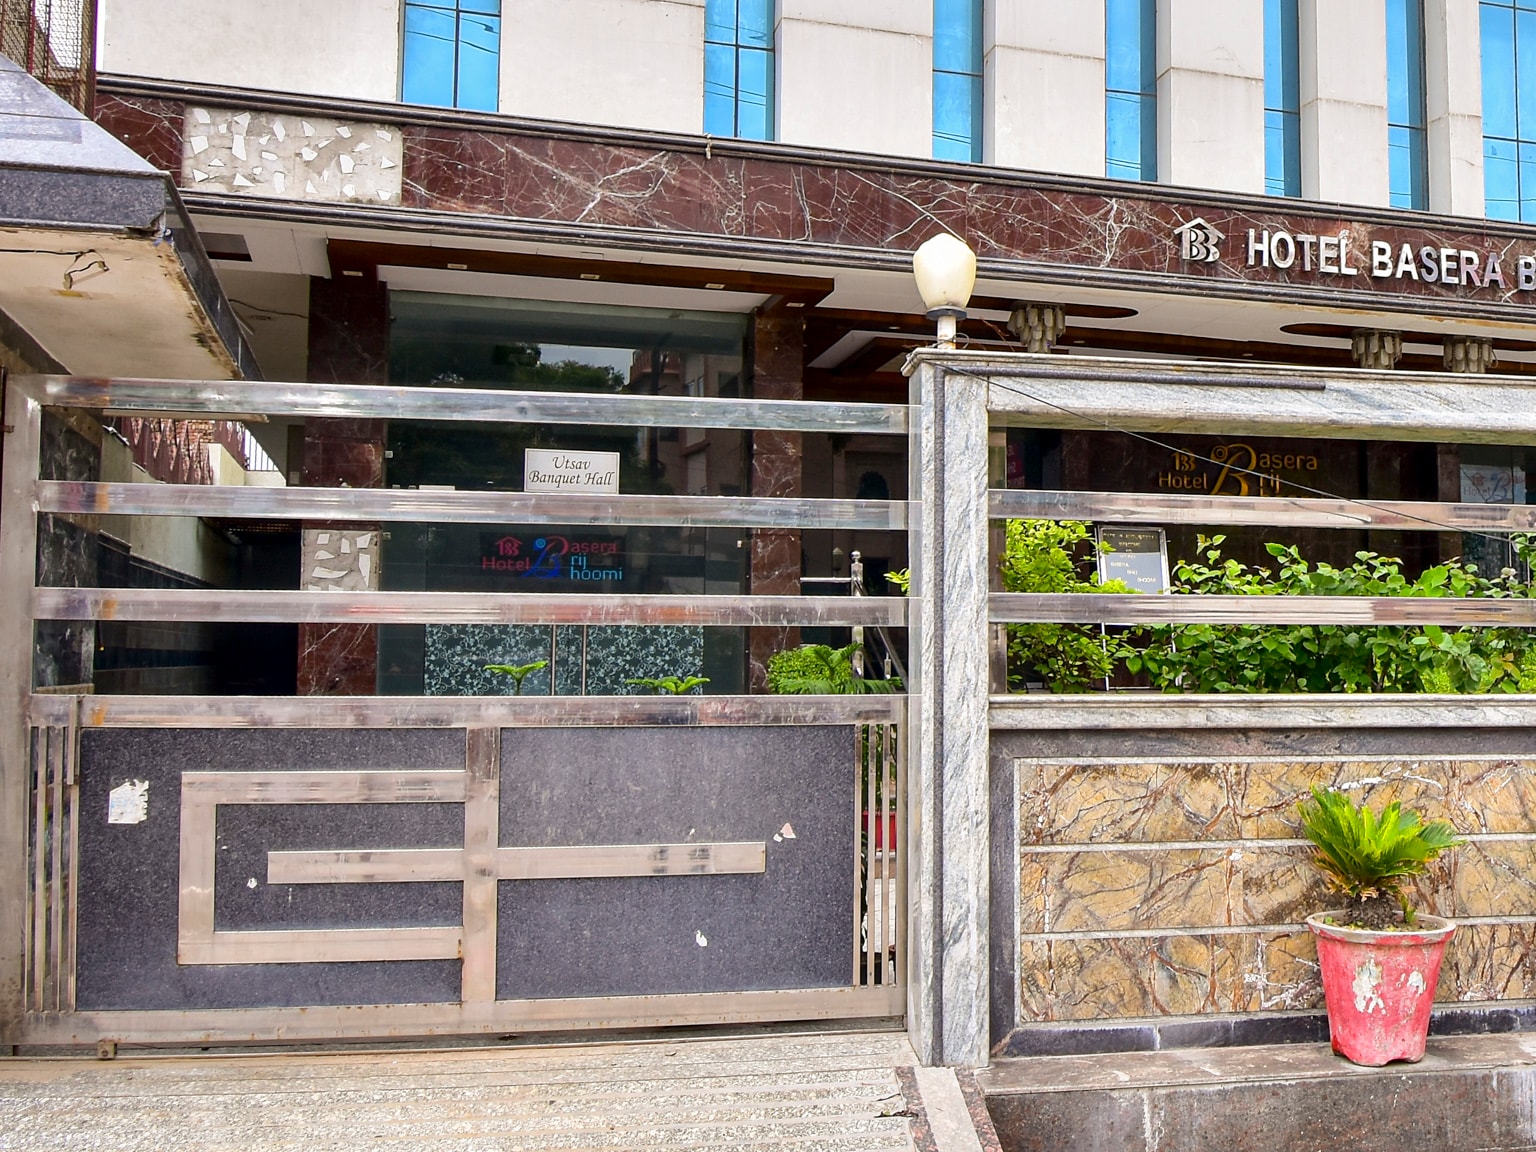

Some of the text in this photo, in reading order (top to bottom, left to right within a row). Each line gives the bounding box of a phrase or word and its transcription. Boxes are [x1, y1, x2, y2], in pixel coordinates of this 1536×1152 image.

[1247, 228, 1358, 276] HOTEL
[1371, 240, 1506, 289] BASERA
[552, 455, 591, 470] Utsav
[528, 470, 615, 488] Banquet Hall
[1158, 472, 1208, 489] Hotel
[482, 556, 530, 571] Hotel
